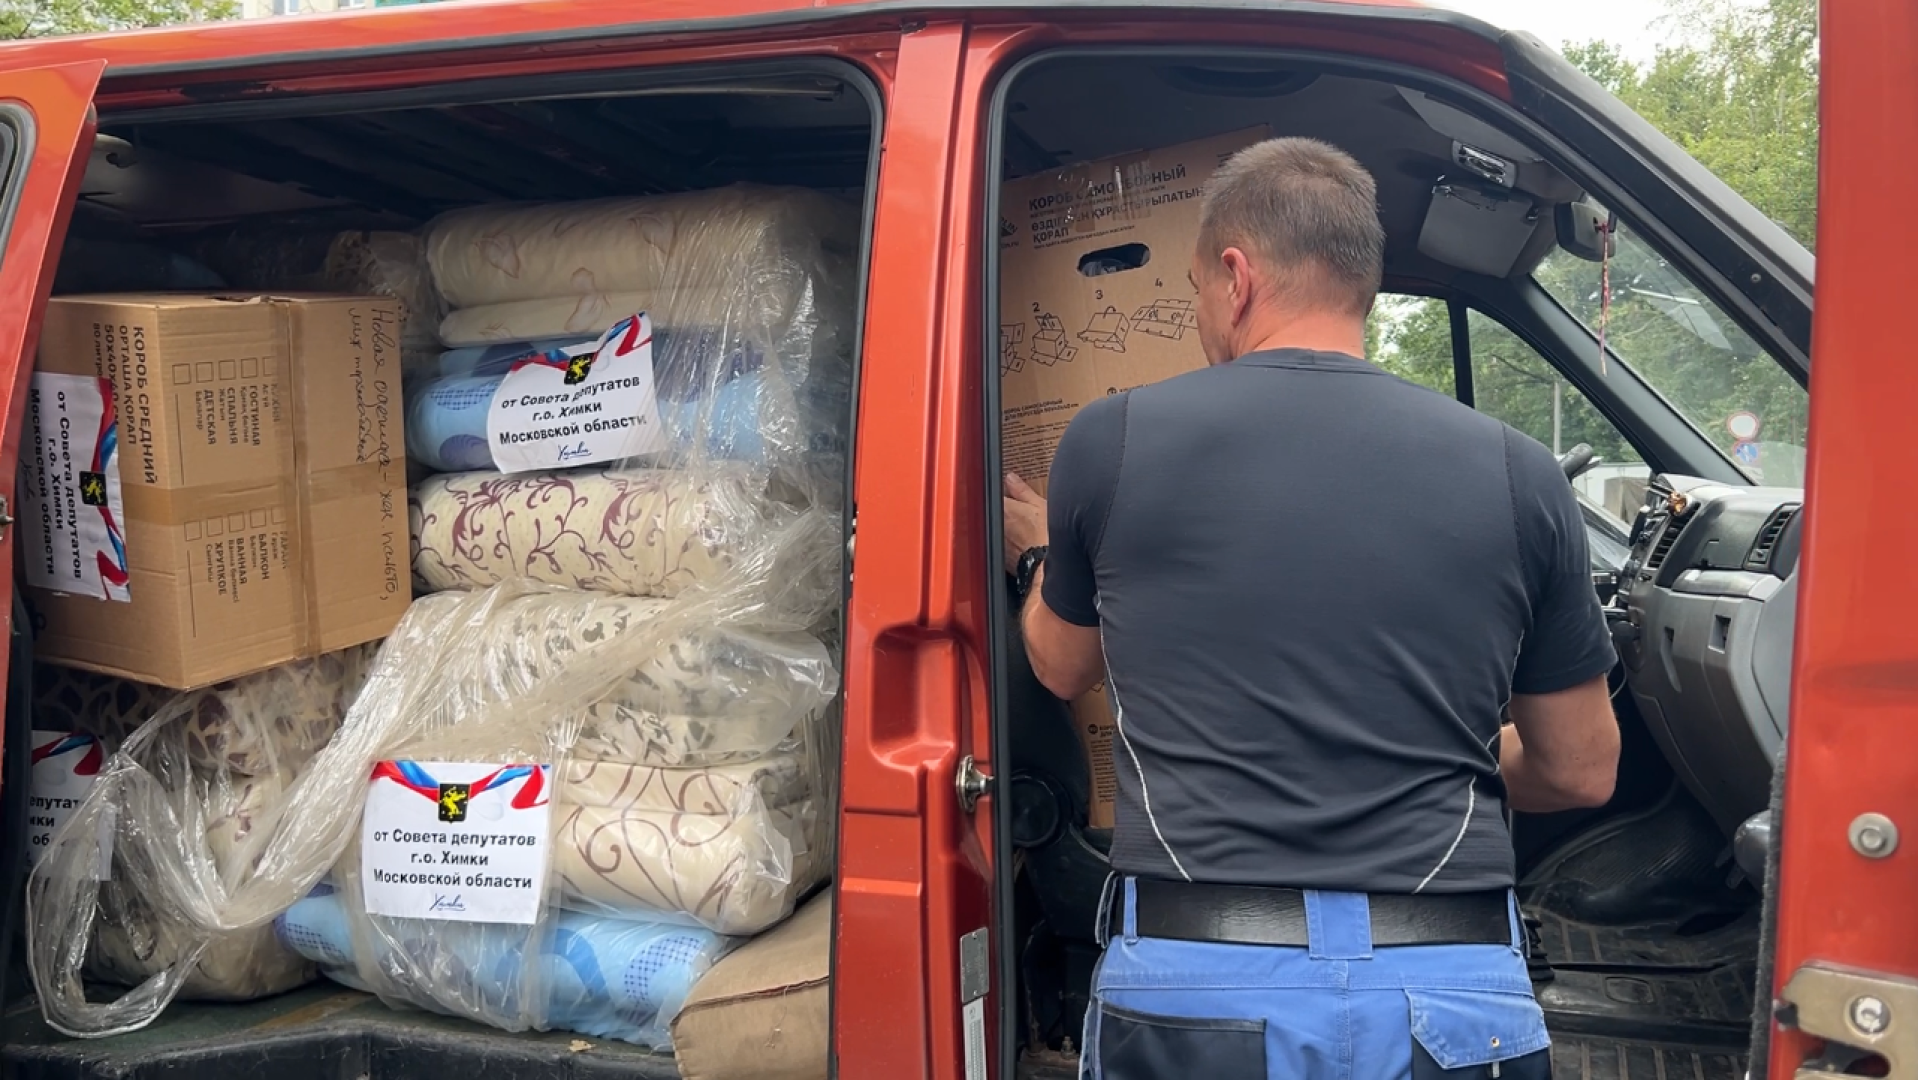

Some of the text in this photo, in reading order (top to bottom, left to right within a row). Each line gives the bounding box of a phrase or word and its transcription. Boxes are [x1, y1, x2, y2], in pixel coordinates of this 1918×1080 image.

[1029, 192, 1073, 211] КОРОБ
[1095, 290, 1103, 299] 3
[1155, 278, 1163, 287] 4
[1032, 302, 1041, 312] 2
[94, 338, 103, 376] литро
[119, 325, 132, 392] ОРТАША
[133, 326, 158, 484] КОРОБ СРЕДНИЙ
[501, 376, 640, 409] от Совета депутатов
[533, 402, 602, 421] г.о. Химки
[204, 389, 217, 445] ДЕТСКАЯ
[227, 387, 238, 444] СПАЛЬНЯ
[249, 385, 261, 446] ГОСТИНАЯ
[499, 415, 647, 445] Московской области
[30, 388, 54, 575] Московской области
[48, 438, 64, 530] г.о. Химки
[57, 391, 82, 579] от Совета депутатов
[215, 542, 228, 595] ХРУПКОЕ
[236, 537, 248, 584] ВАННАЯ
[259, 533, 270, 580] БАЛКОН
[30, 796, 80, 810] епутат
[374, 828, 537, 848] от Совета депутатов
[410, 851, 489, 866] г.о. Химки
[373, 868, 532, 889] Московской области
